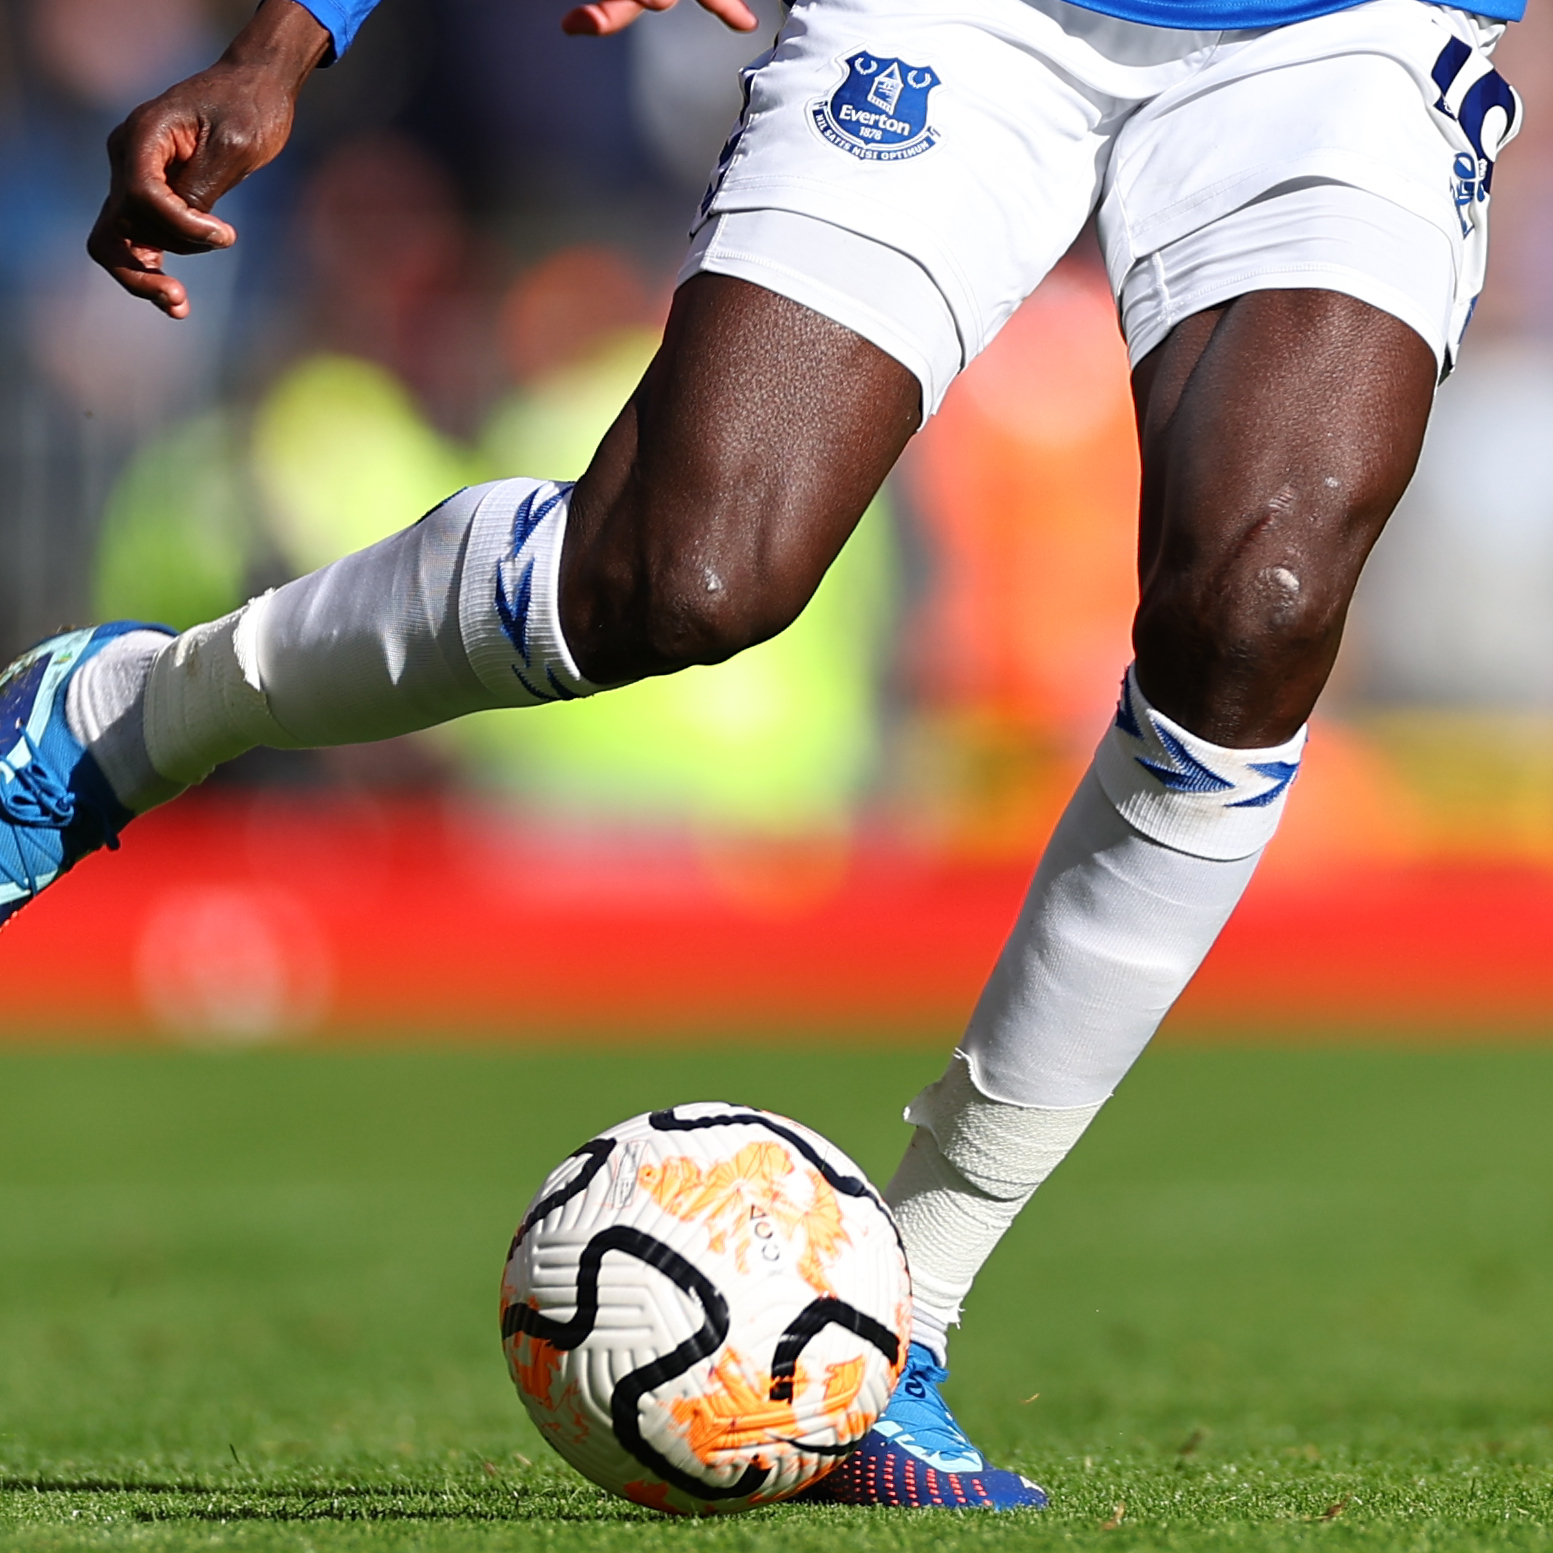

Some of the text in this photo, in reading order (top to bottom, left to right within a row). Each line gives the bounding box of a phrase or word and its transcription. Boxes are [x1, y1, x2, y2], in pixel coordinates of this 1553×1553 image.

[839, 104, 911, 136] Everton
[859, 126, 883, 141] 1878
[814, 113, 930, 161] NIL SATIS NISI OPTIMUM
